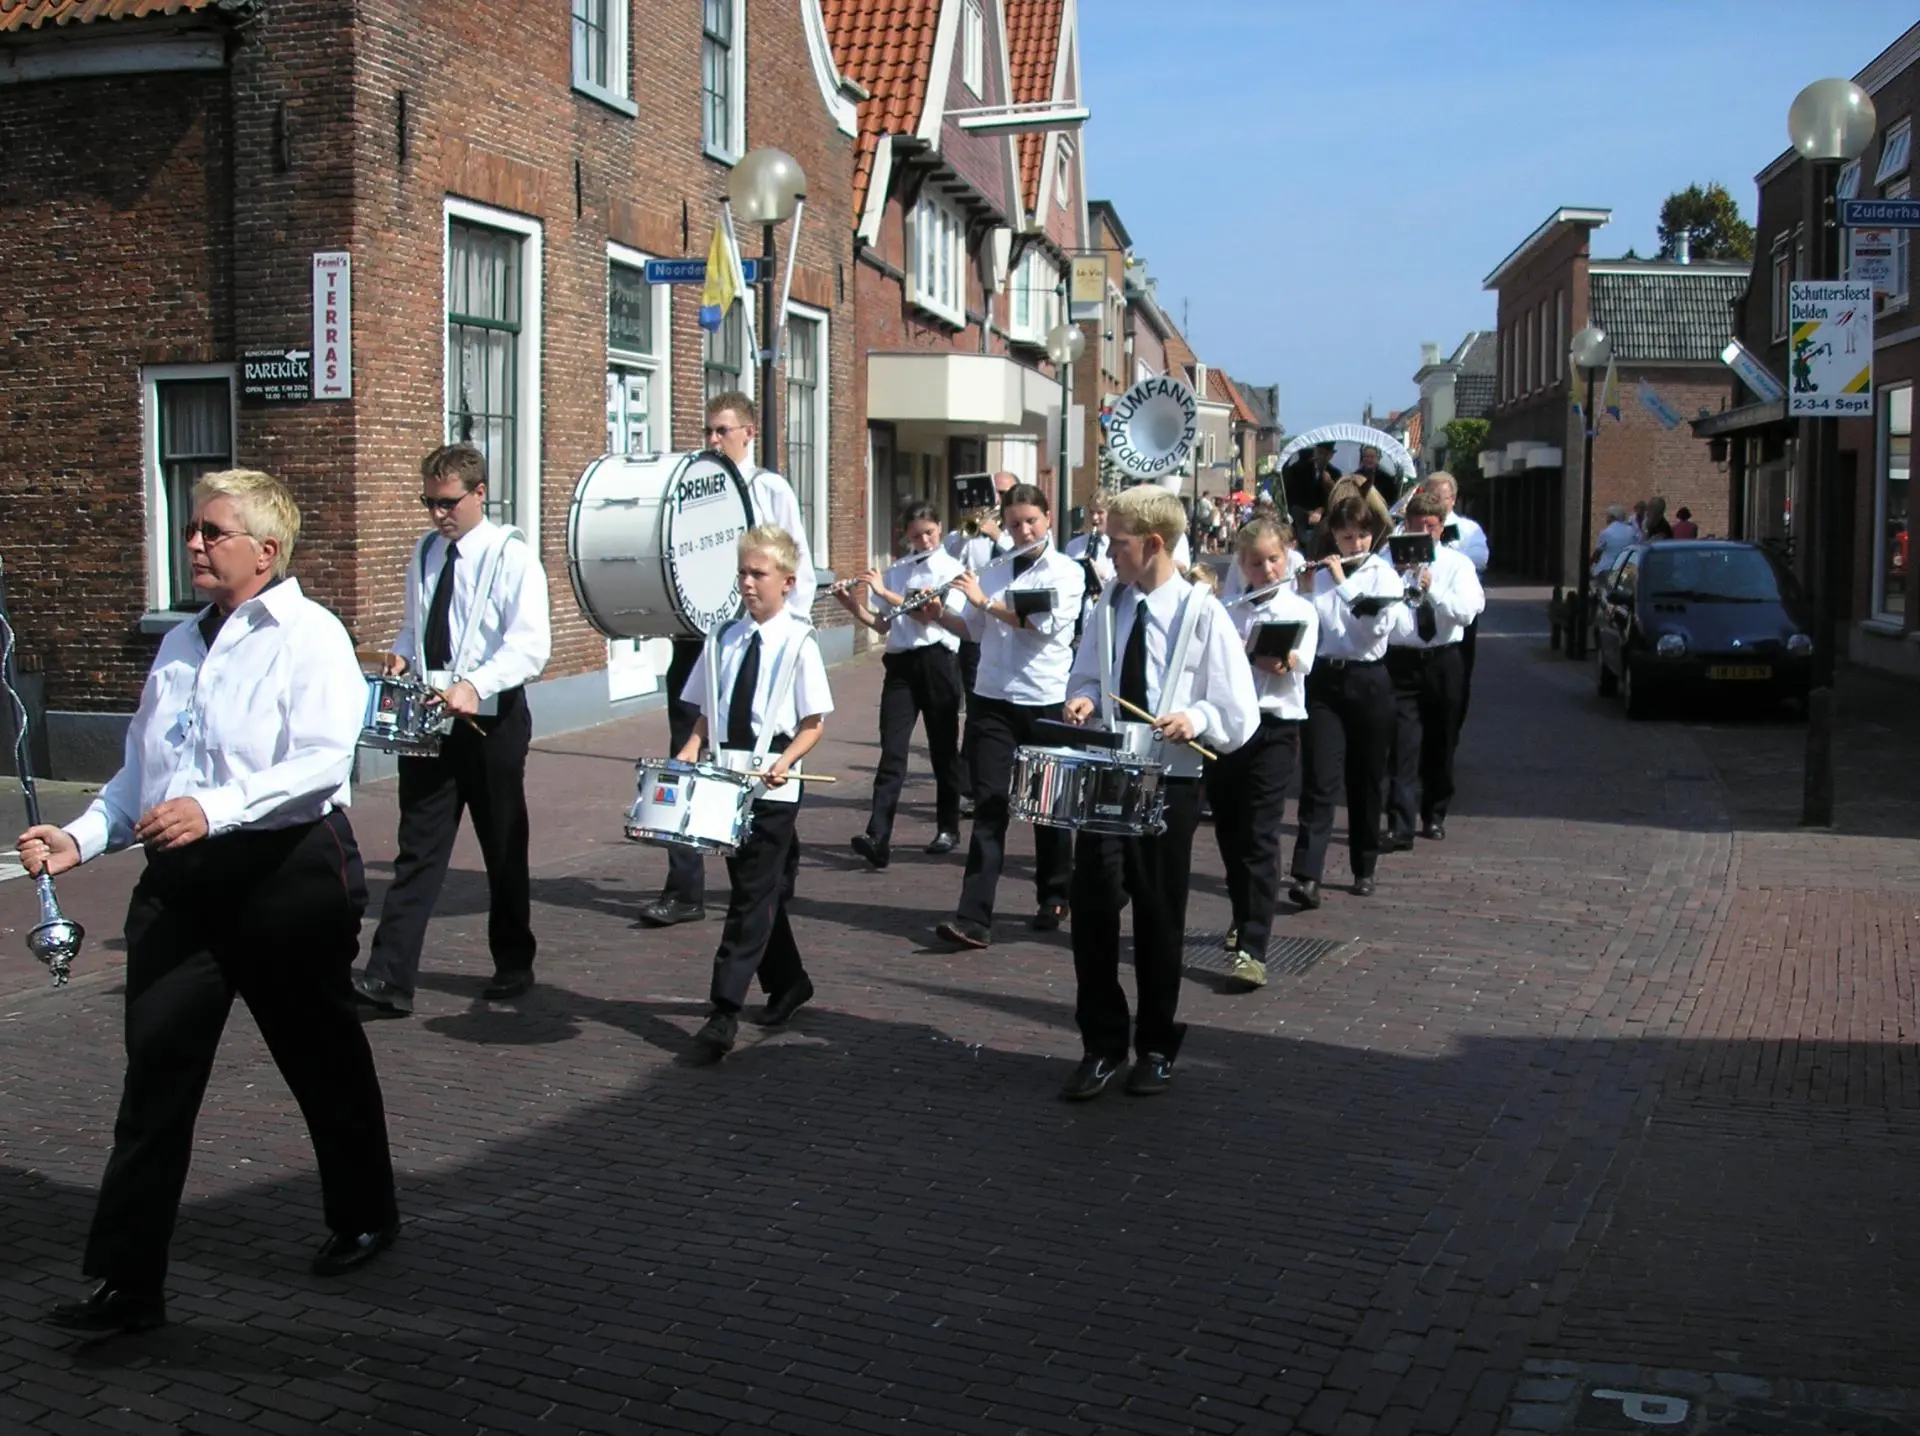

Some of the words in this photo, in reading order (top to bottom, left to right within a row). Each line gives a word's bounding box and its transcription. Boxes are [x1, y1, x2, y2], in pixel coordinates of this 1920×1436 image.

[1792, 284, 1871, 301] Schuttersfeest
[1792, 303, 1828, 320] Delden
[325, 272, 338, 380] TERRAS
[245, 361, 308, 380] RAREKIEK
[1793, 400, 1829, 410] 2-3-4
[1835, 399, 1870, 411] Sept
[1111, 379, 1196, 457] DRUMFANFARE
